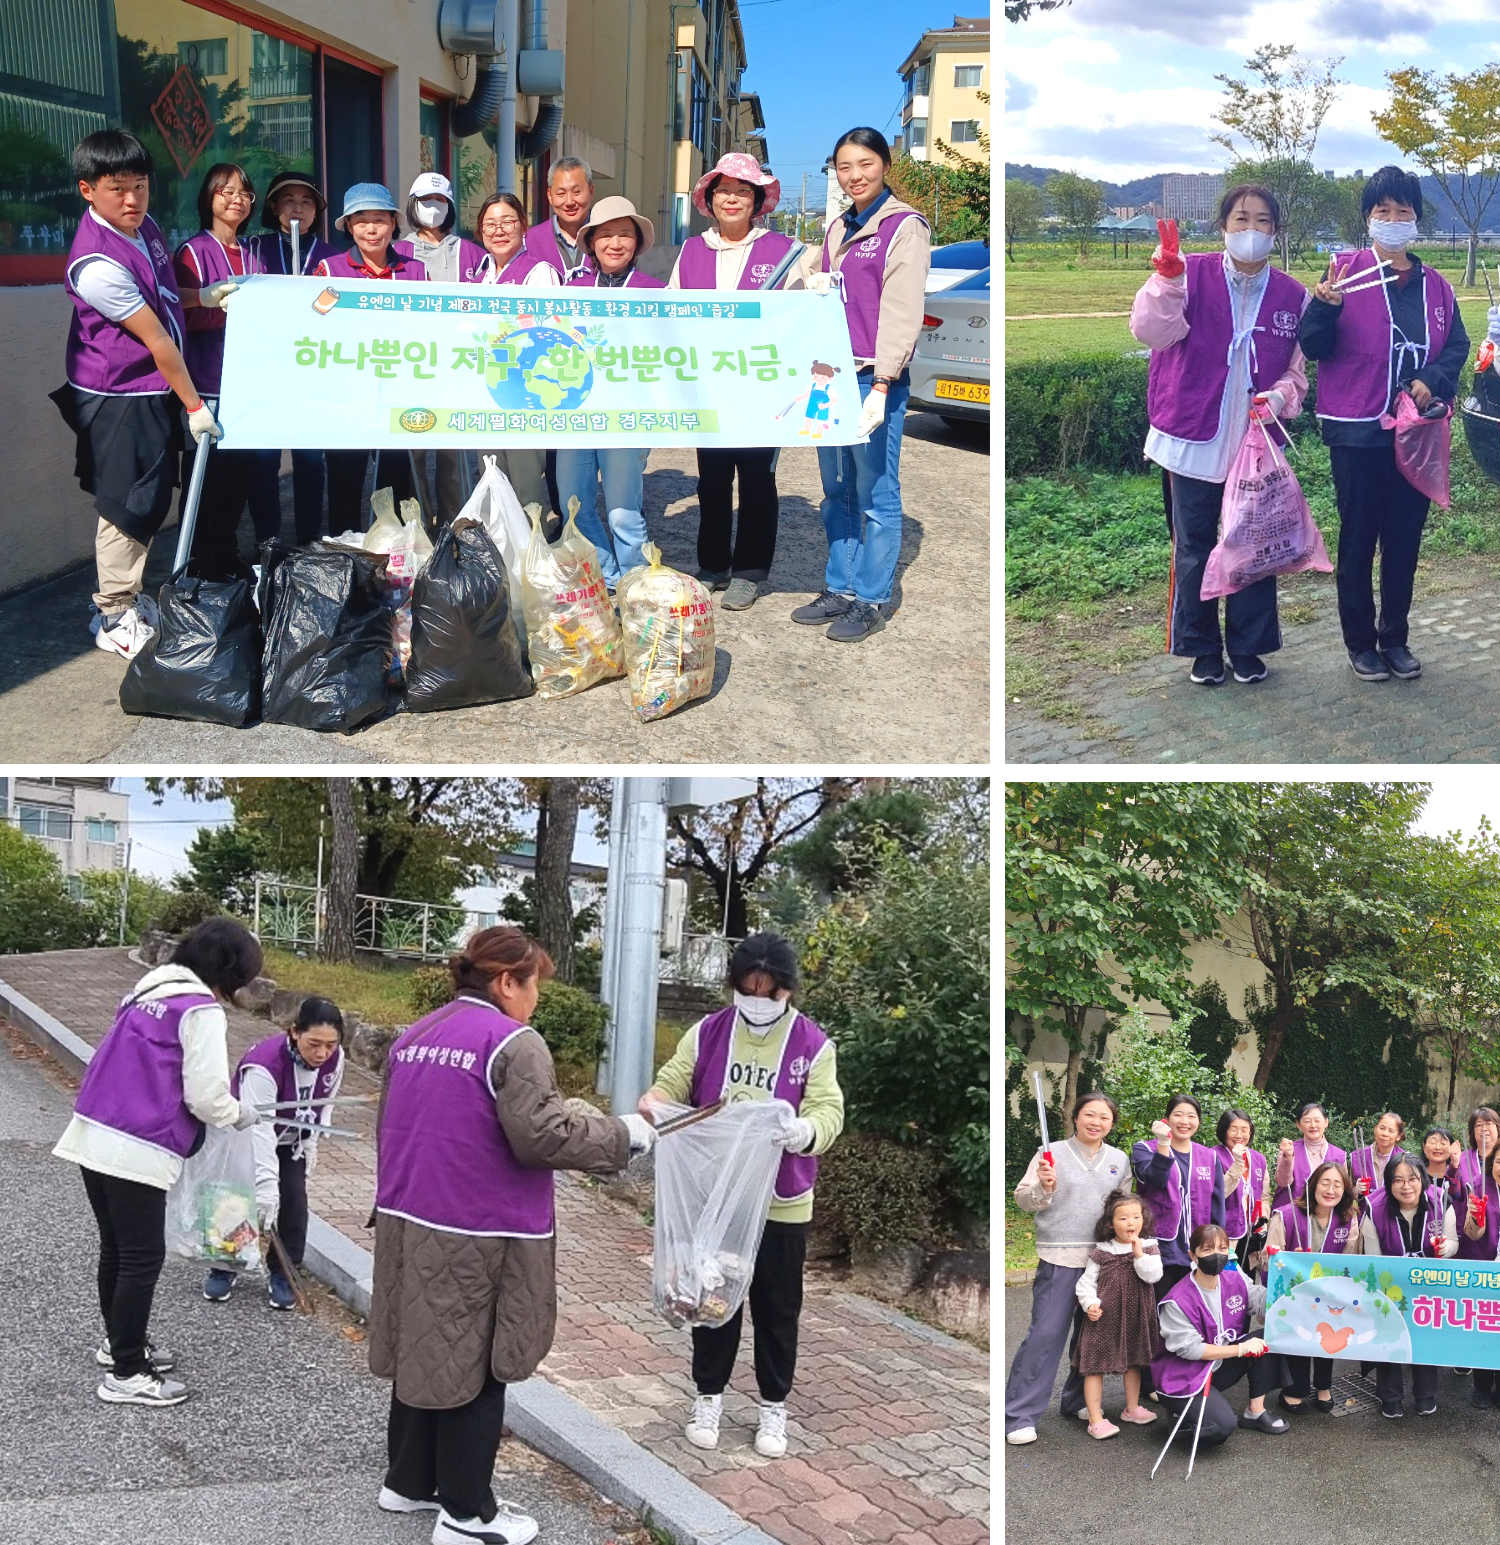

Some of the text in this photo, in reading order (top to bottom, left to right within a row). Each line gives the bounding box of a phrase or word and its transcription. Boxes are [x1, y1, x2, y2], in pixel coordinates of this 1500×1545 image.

[854, 251, 877, 259] WFWP
[357, 294, 396, 310] 유엔의
[400, 296, 414, 311] 날
[418, 296, 443, 312] 기념
[448, 296, 484, 312] 제8차
[487, 298, 511, 314] 전국
[515, 299, 539, 314] 동시
[544, 300, 593, 316] 봉사활동
[604, 301, 630, 317] 환경
[634, 302, 660, 317] 지킴
[664, 303, 704, 318] 캠페인
[294, 336, 798, 382] 하나뿐인 지구, 한 번뿐인 지금.
[618, 412, 701, 431] 경주지부
[1409, 1268, 1451, 1286] 유엔의
[1455, 1270, 1471, 1287] 날
